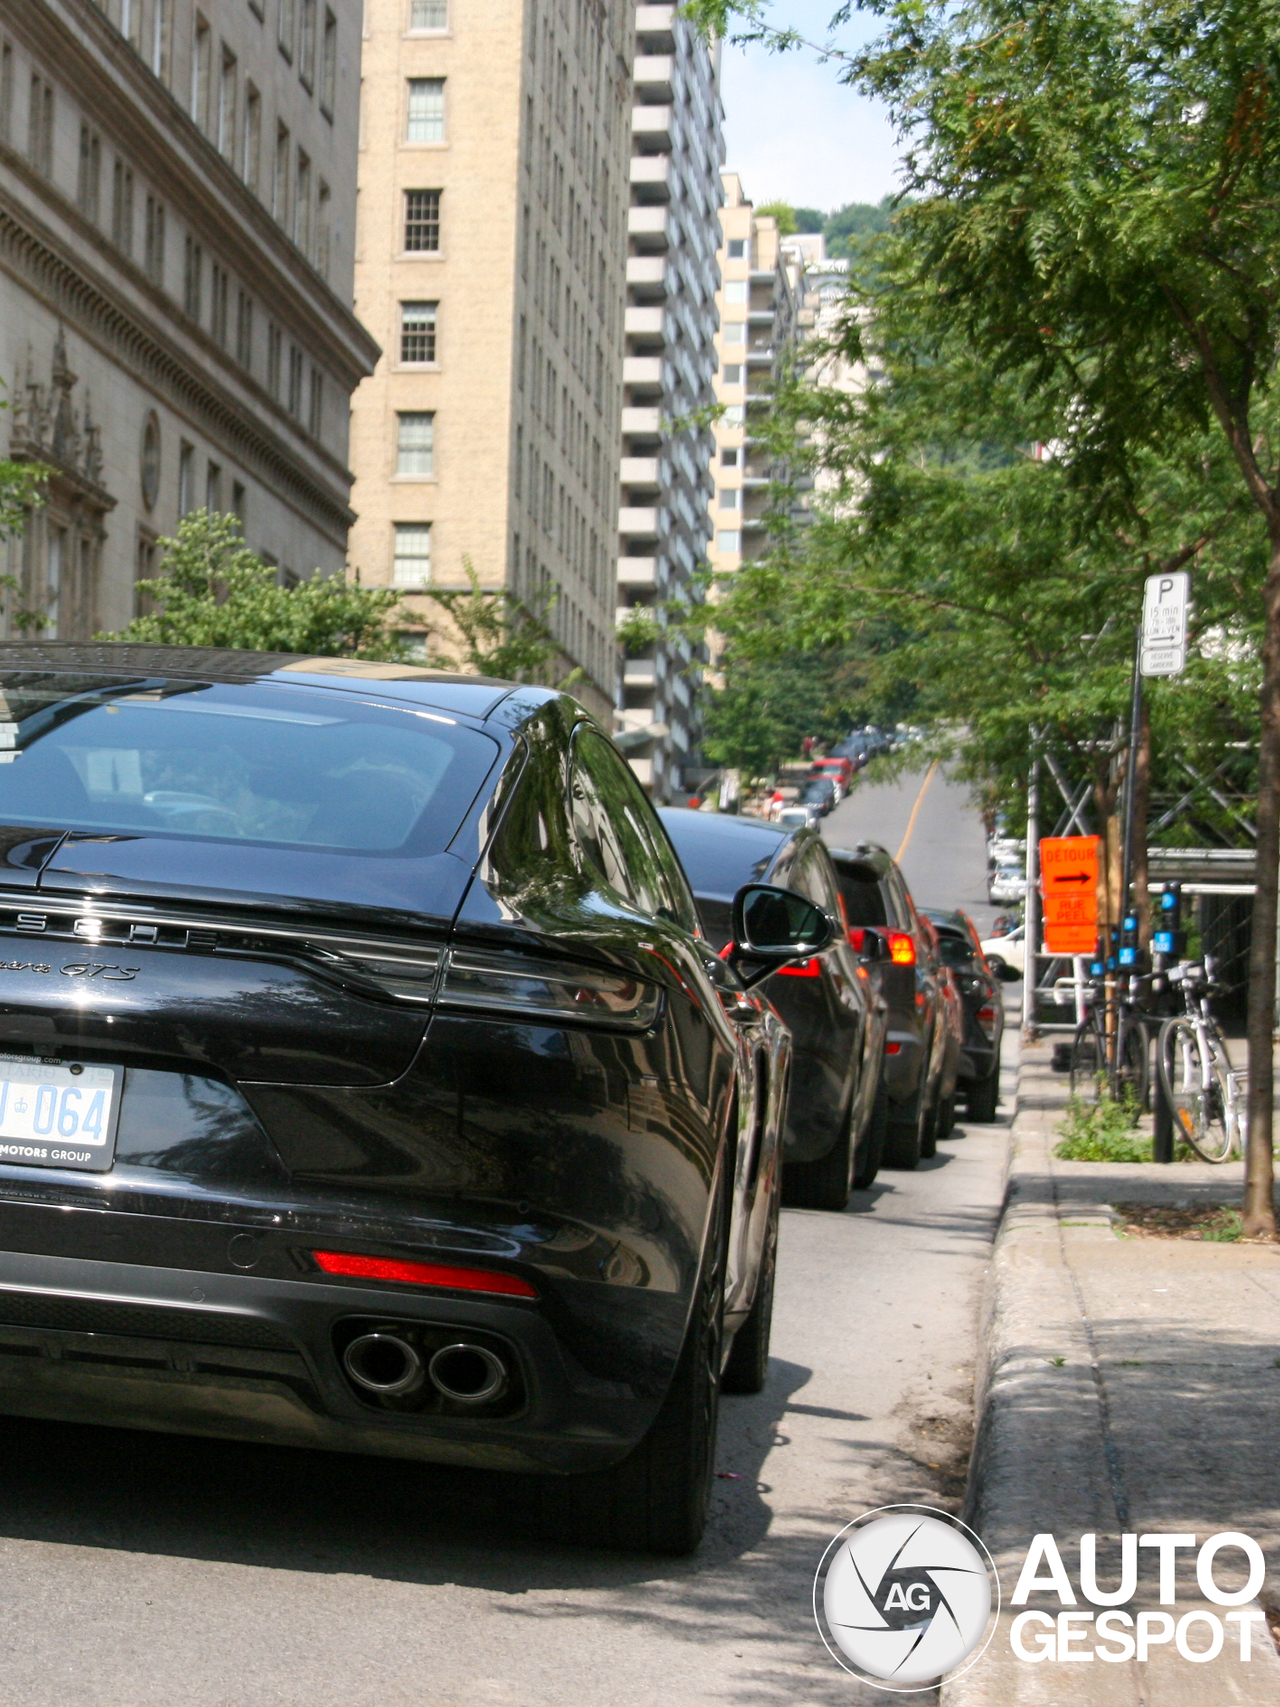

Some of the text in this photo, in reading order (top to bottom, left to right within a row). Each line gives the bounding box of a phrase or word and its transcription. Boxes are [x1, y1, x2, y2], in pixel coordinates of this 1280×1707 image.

[1158, 579, 1174, 605] P
[1150, 606, 1179, 618] 15 min
[1167, 625, 1180, 635] VEN
[1046, 847, 1095, 863] DÉTOUR
[1059, 899, 1085, 910] RUE
[1056, 911, 1089, 921] PEEL
[59, 962, 140, 980] GTS
[33, 1084, 105, 1139] 064
[51, 1149, 92, 1162] GROUP
